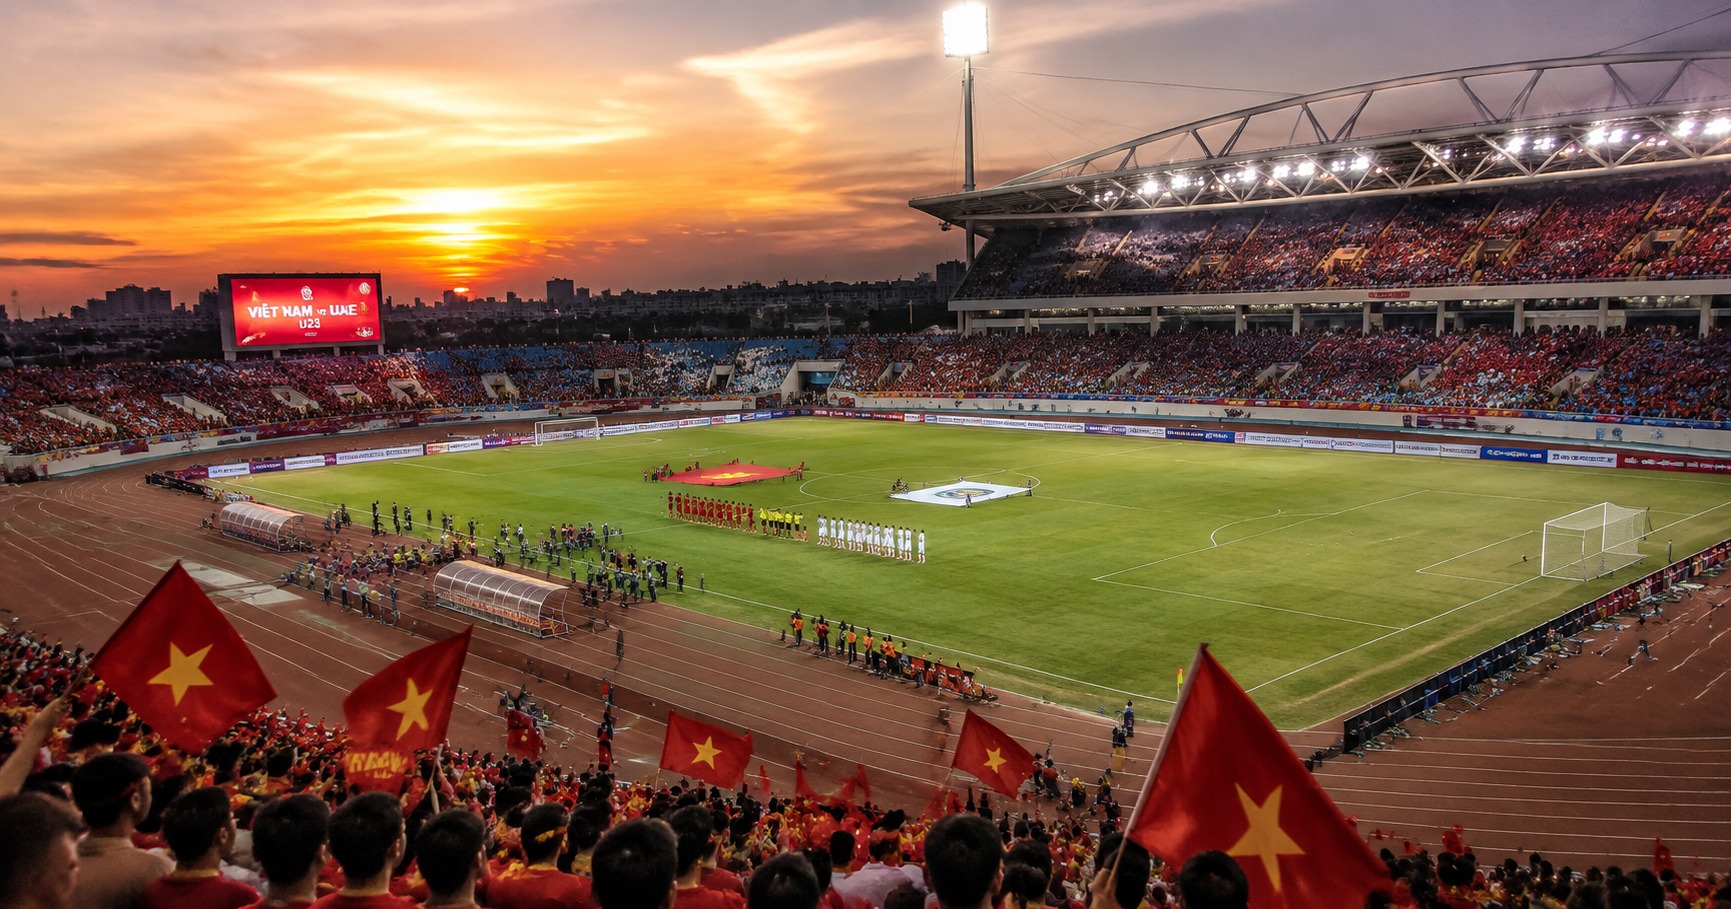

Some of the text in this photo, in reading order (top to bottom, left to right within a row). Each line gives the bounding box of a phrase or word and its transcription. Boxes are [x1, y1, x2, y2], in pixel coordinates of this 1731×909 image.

[281, 305, 313, 318] NAM
[329, 304, 358, 316] UAE
[299, 318, 321, 329] U23
